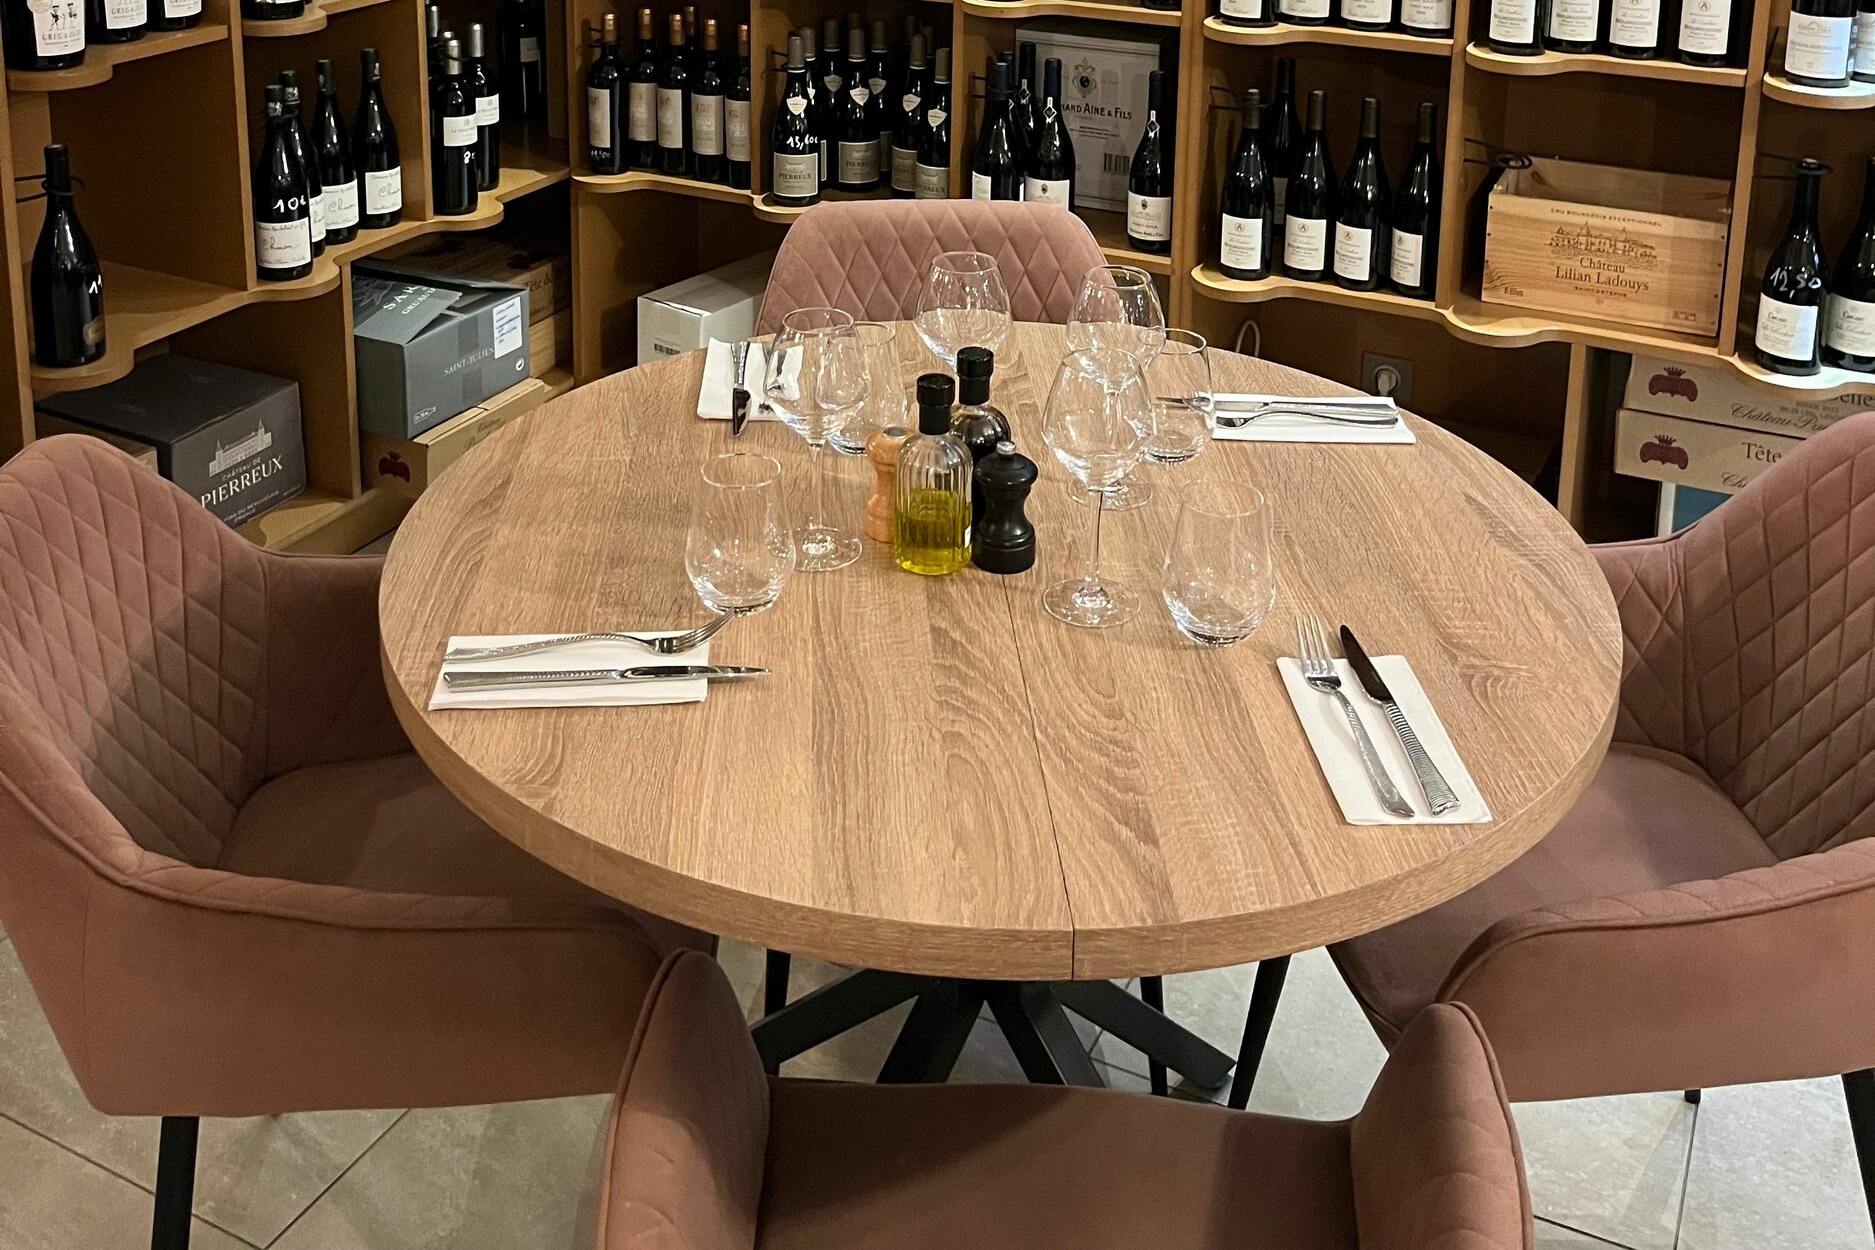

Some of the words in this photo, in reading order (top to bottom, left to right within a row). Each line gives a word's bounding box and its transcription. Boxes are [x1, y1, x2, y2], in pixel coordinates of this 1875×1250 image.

[111, 7, 128, 15] GREG
[42, 32, 63, 42] GREG
[1114, 107, 1133, 120] FILS
[1567, 210, 1607, 220] BOURGEOIS
[1608, 216, 1663, 228] EXCEPTIONNEL
[1580, 257, 1626, 274] Château
[1555, 266, 1592, 283] Lilian
[1596, 272, 1650, 293] Ladouys
[444, 347, 495, 376] SAINT-JULIEN
[1731, 402, 1792, 426] Château
[1741, 441, 1782, 463] Tête
[201, 454, 283, 508] PIERREUX
[222, 461, 252, 481] CHÂTEAU
